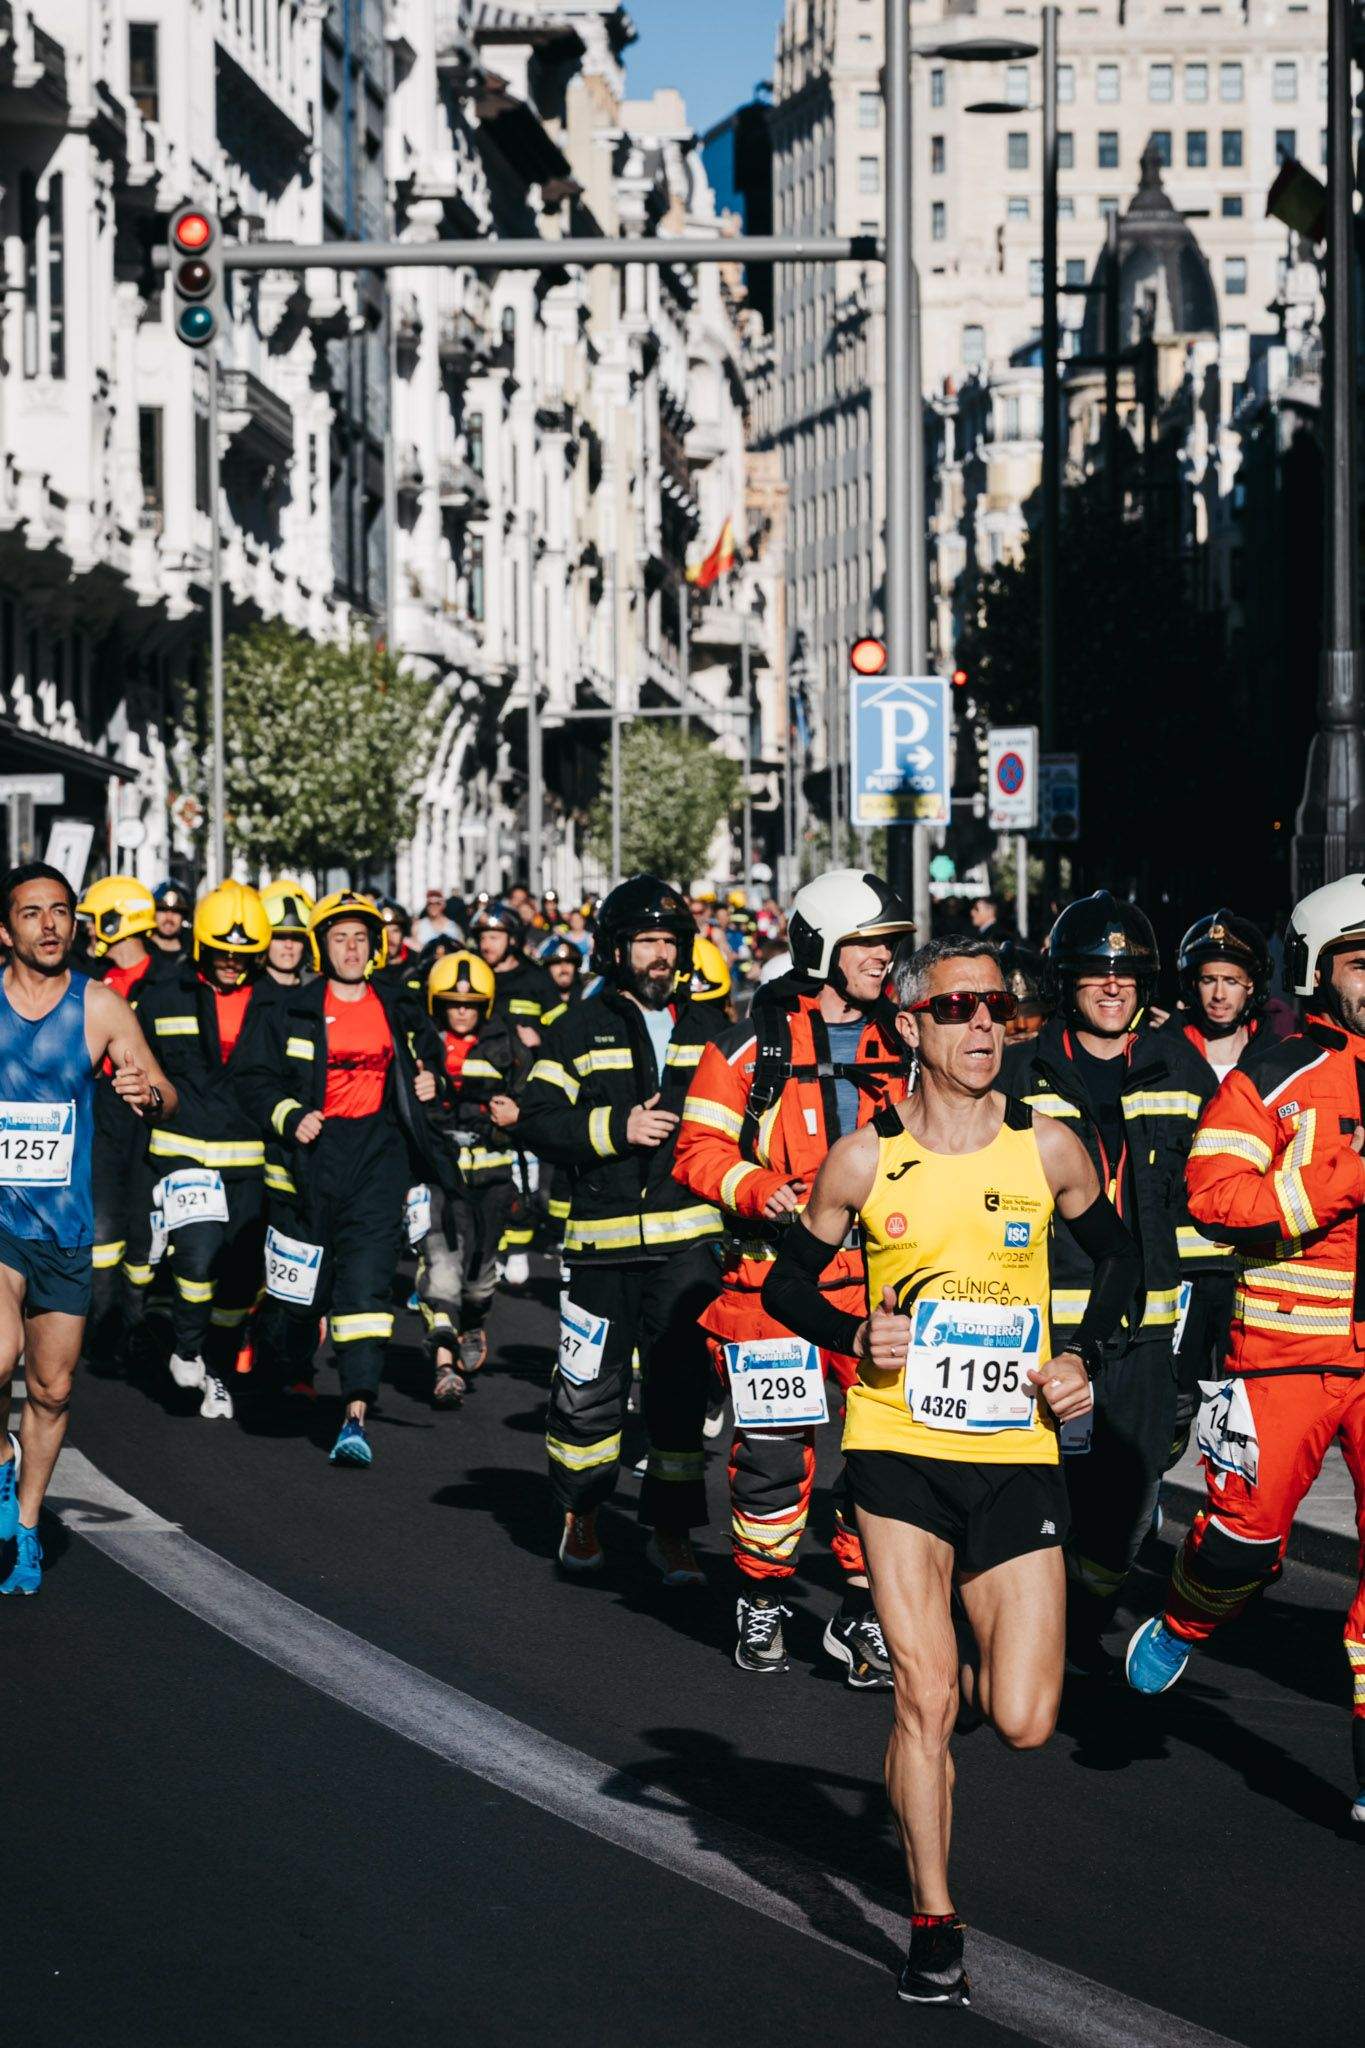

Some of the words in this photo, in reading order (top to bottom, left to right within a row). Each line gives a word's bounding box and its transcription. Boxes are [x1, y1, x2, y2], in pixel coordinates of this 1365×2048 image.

[872, 700, 930, 776] P
[1280, 1102, 1296, 1116] 957
[0, 1138, 60, 1161] 1257
[177, 1192, 208, 1208] 921
[1007, 1227, 1028, 1242] ISC
[988, 1251, 1034, 1262] AVODENT
[269, 1259, 299, 1283] 926
[943, 1277, 1011, 1295] CLÍNICA
[956, 1323, 1022, 1336] BOMBEROS
[936, 1356, 1019, 1393] 1195
[747, 1376, 806, 1400] 1298
[920, 1395, 968, 1419] 4326
